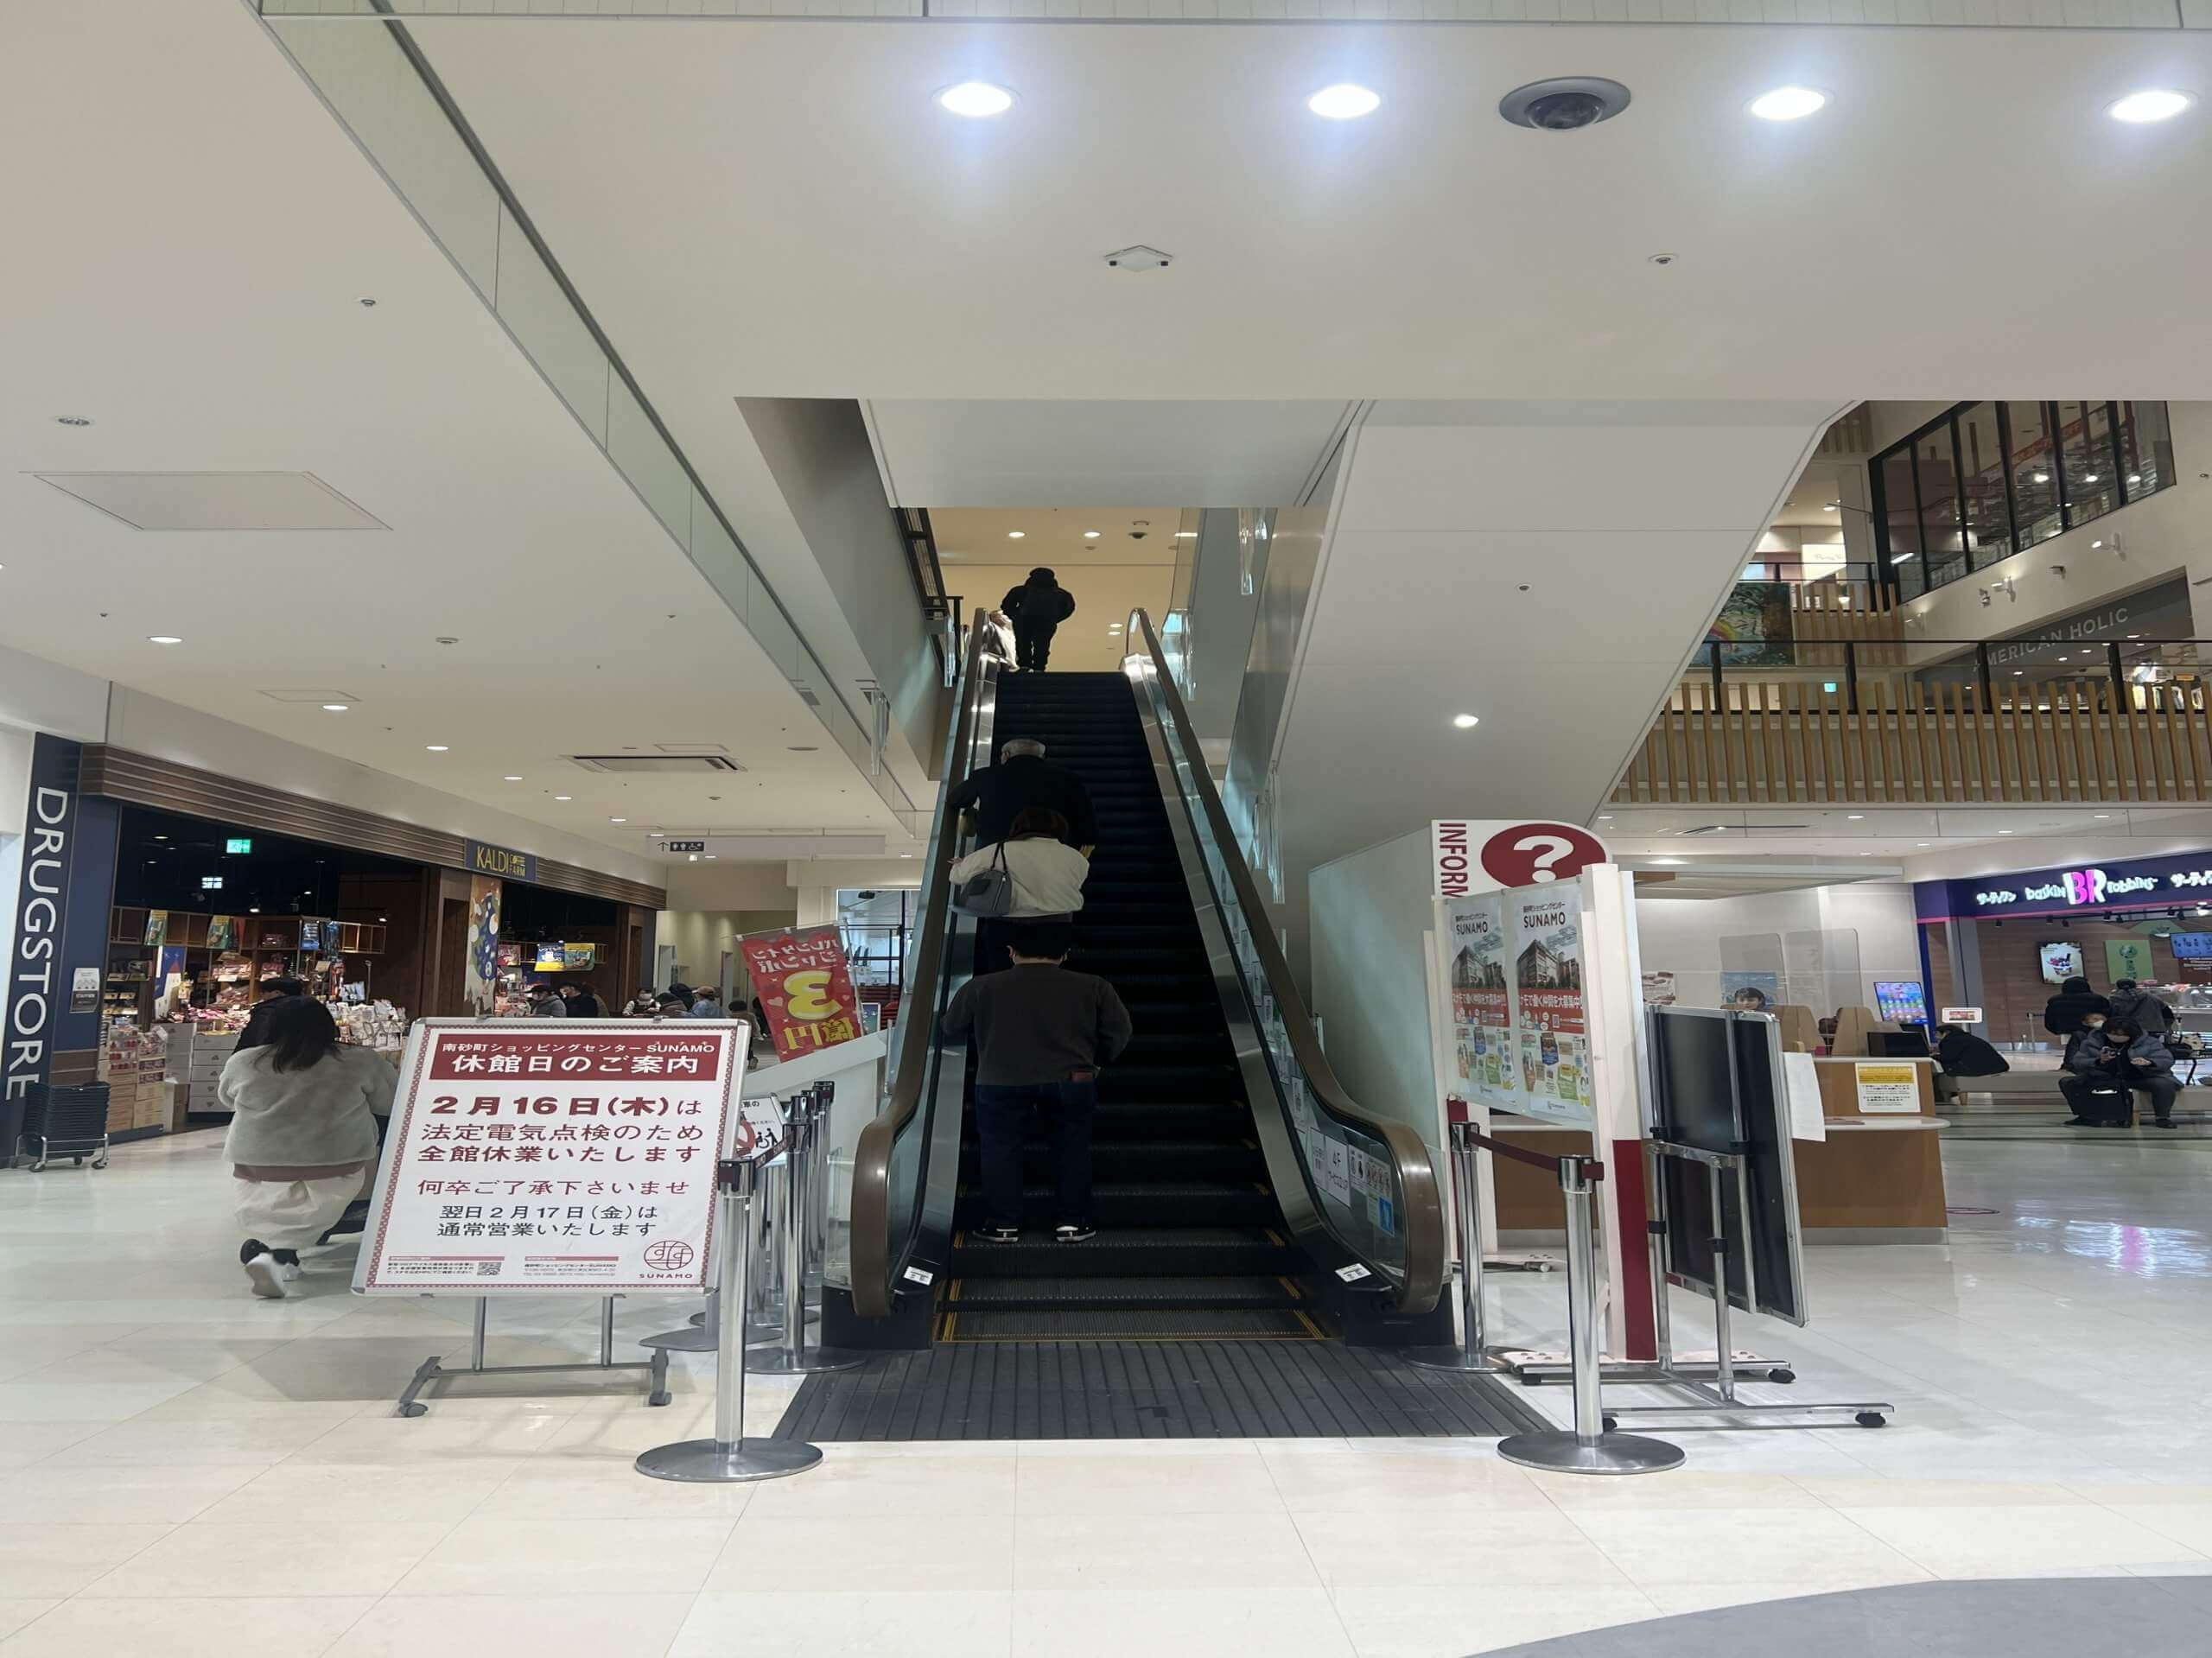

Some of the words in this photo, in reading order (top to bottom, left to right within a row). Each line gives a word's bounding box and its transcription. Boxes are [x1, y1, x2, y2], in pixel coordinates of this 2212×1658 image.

[2069, 607, 2129, 639] HOLIC
[476, 845, 509, 873] KALDI
[1455, 921, 1489, 936] SUNAMO
[1523, 912, 1566, 929] SUNAMO
[5, 786, 68, 1101] DRUGSTORE
[442, 1042, 641, 1053] 南砂町ショッピングセンター
[646, 1044, 715, 1053] SUNAMO
[451, 1054, 699, 1074] 休館日のご案内
[421, 1123, 704, 1141] 法定電気点検のため
[416, 1145, 702, 1163] 全館休業いたします
[417, 1179, 690, 1195] 何卒ご了承下さいませ
[436, 1222, 657, 1236] 通常営業いたします
